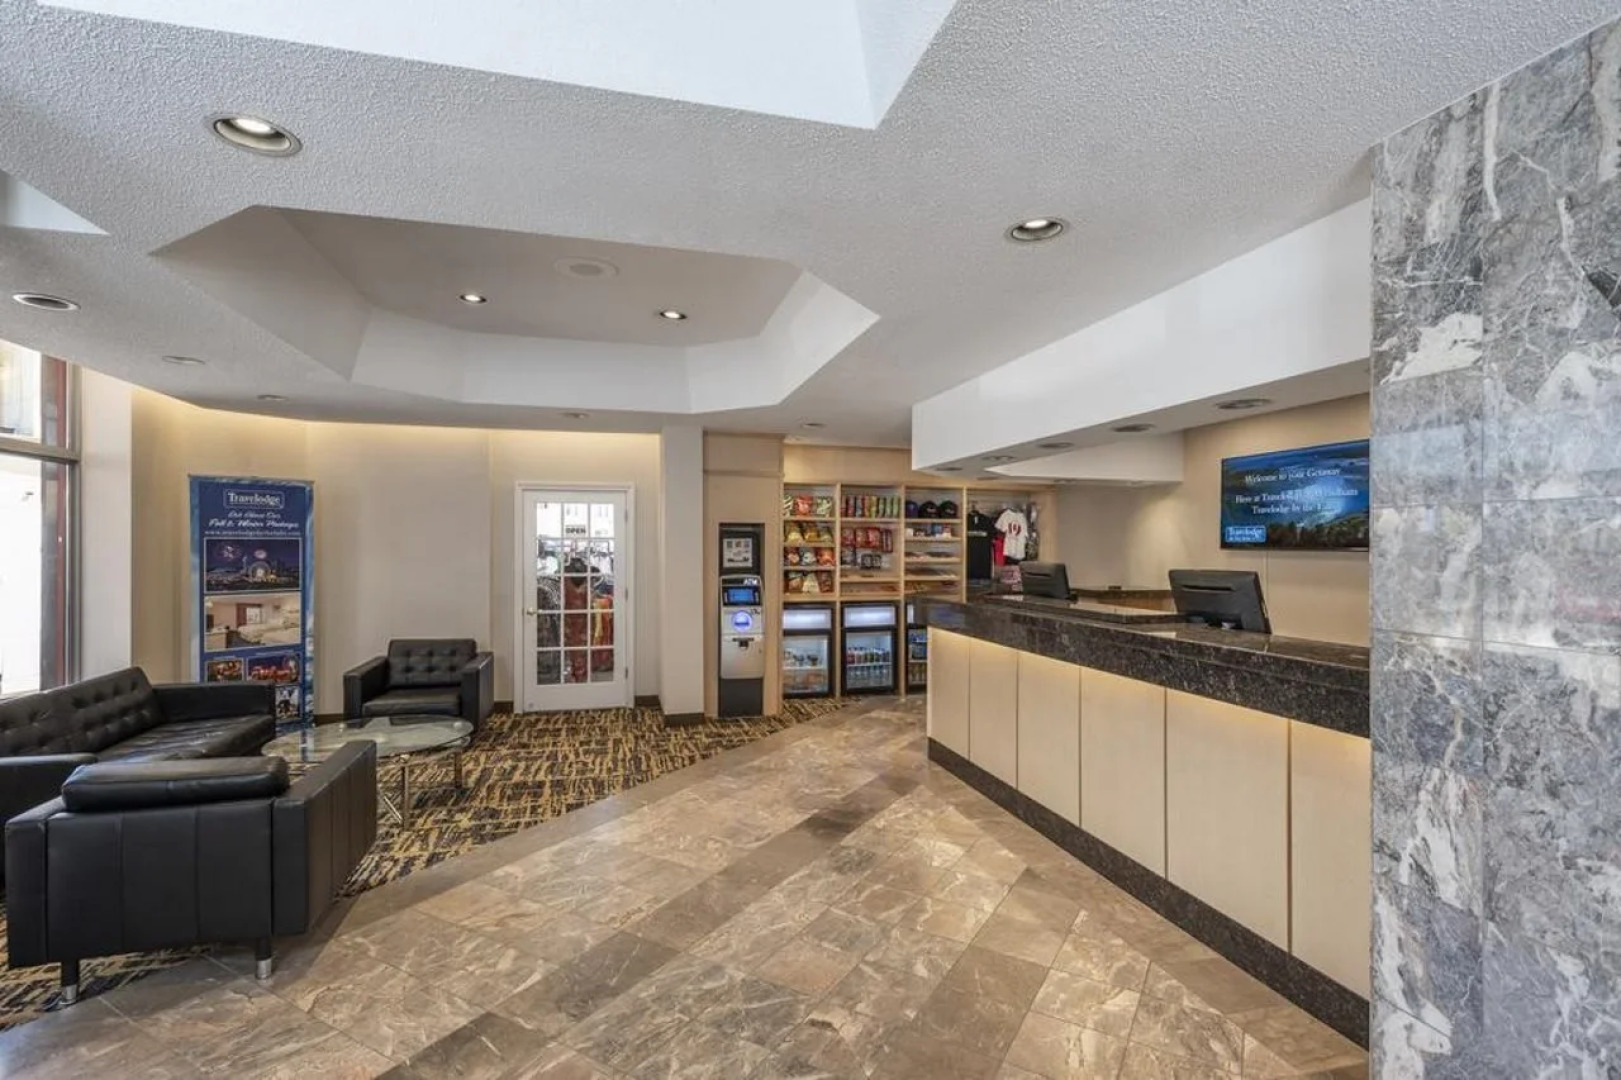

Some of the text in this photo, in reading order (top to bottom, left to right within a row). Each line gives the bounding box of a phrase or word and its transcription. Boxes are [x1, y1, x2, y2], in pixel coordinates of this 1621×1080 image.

[1245, 474, 1277, 484] Welcome
[1279, 473, 1287, 481] to
[228, 492, 281, 506] Travelodge
[237, 519, 264, 528] Winter
[743, 578, 758, 586] ATM
